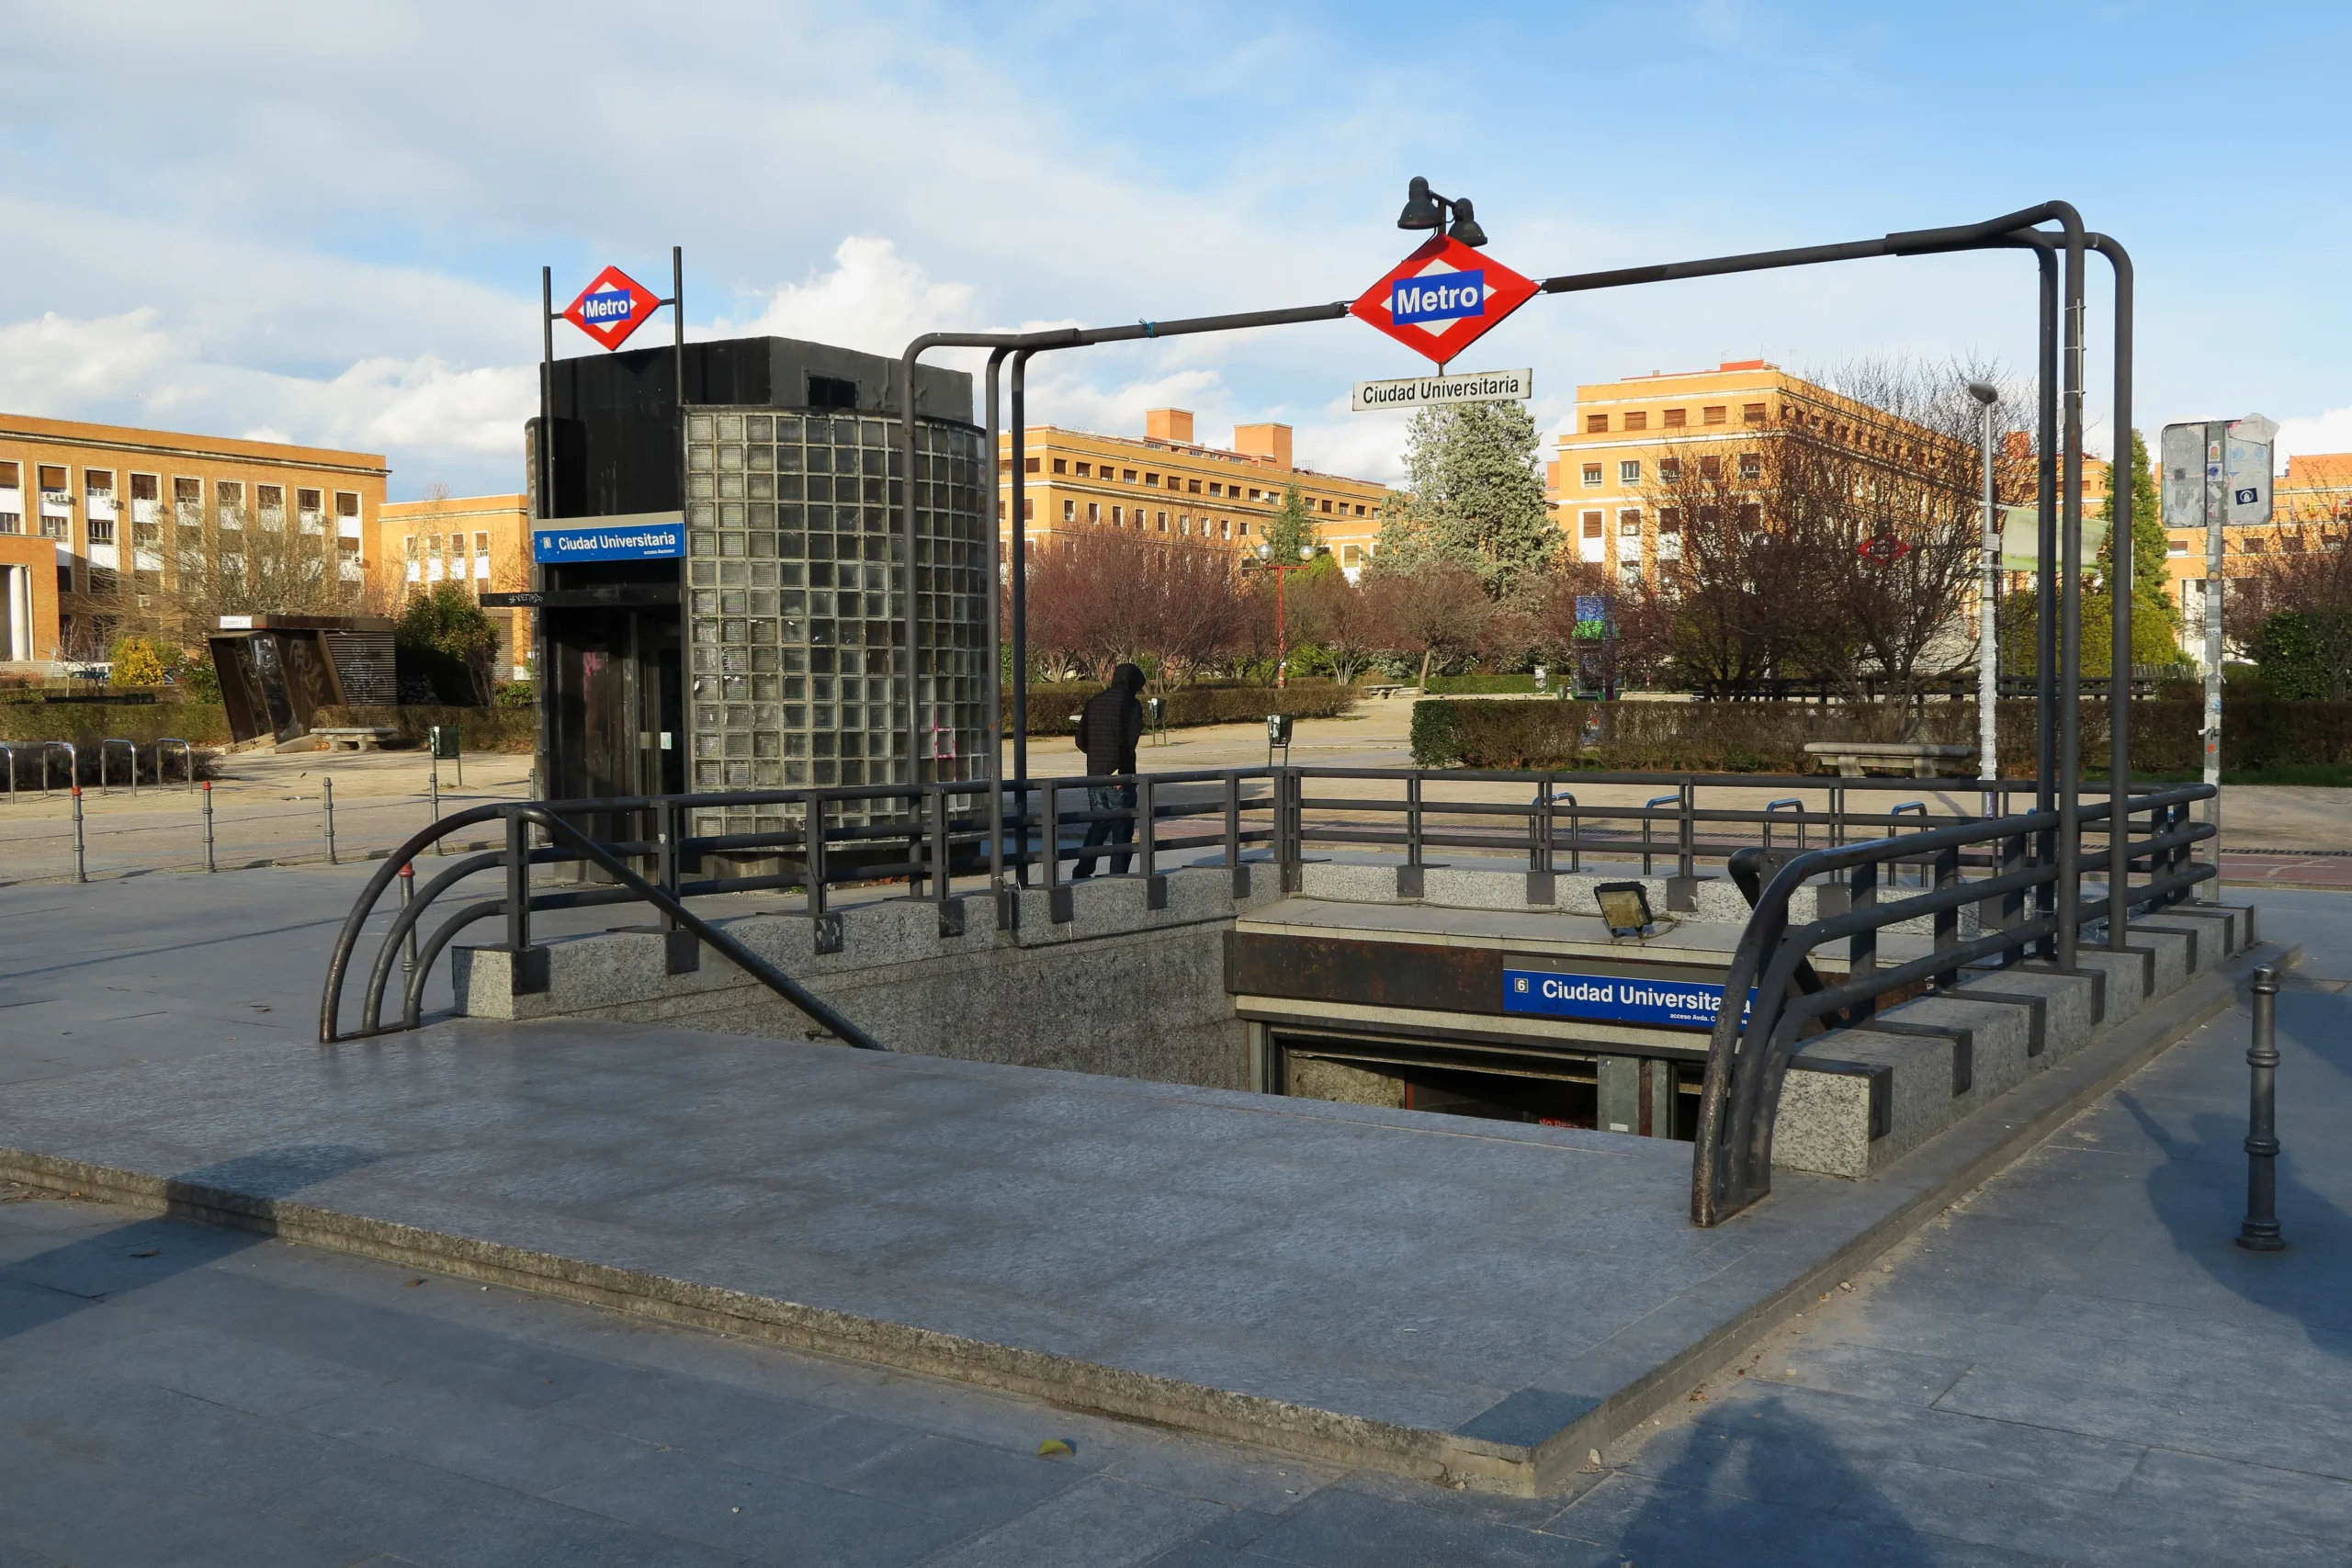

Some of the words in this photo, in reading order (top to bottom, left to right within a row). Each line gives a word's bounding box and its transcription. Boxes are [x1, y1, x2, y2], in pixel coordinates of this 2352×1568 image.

[585, 299, 628, 319] Metro
[1397, 285, 1478, 315] Metro
[1363, 382, 1416, 404] Ciudad
[1420, 376, 1519, 399] Universitaria
[559, 536, 598, 551] Ciudad
[599, 532, 676, 549] Universitaria
[1518, 980, 1526, 991] 6
[1542, 979, 1613, 1004] Ciudad
[1620, 985, 1751, 1014] Universitaa
